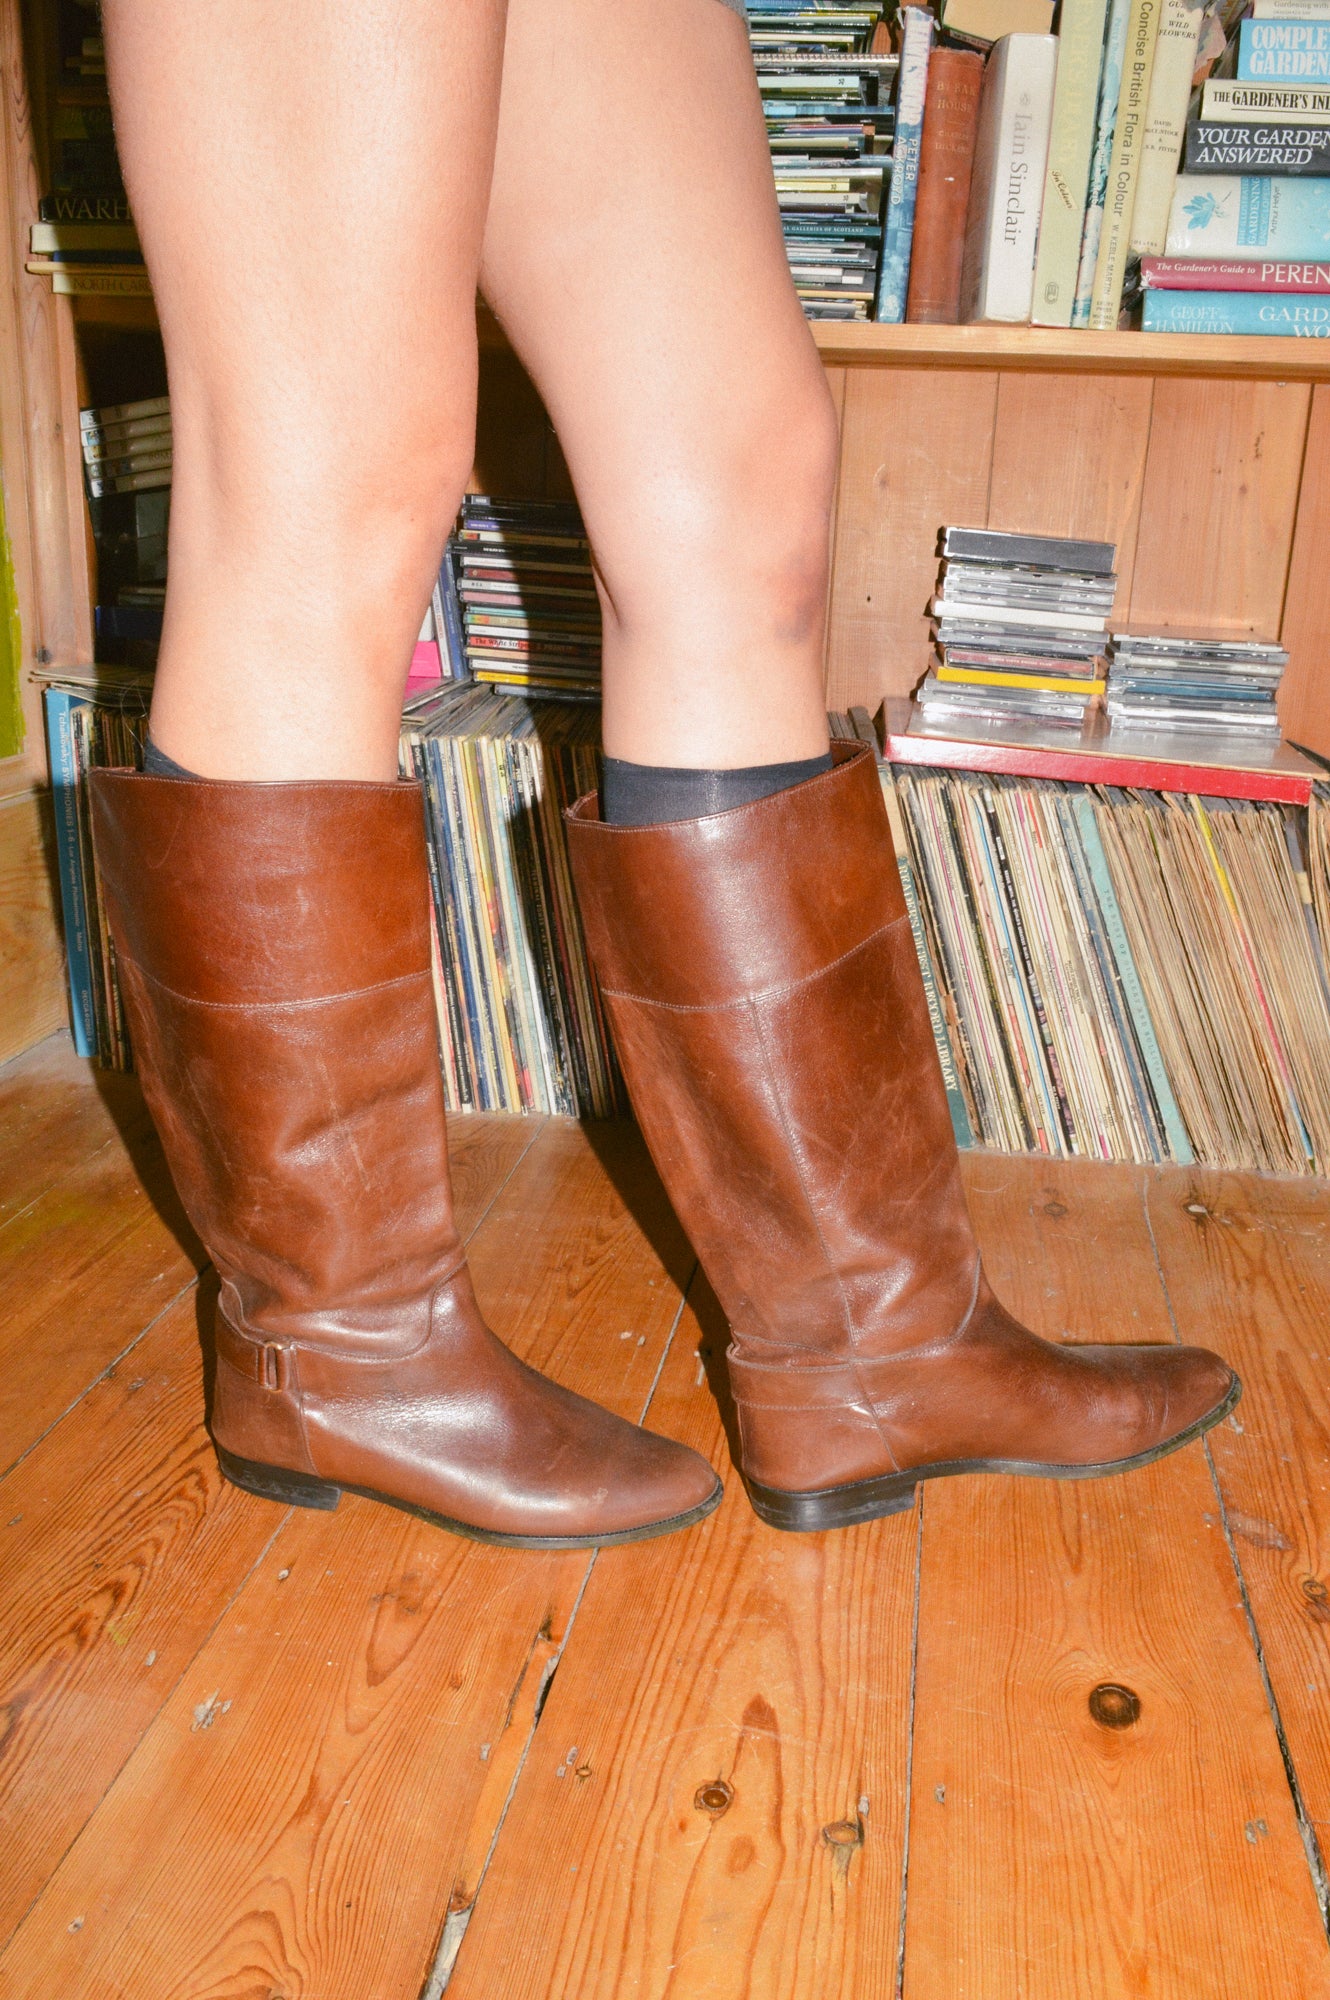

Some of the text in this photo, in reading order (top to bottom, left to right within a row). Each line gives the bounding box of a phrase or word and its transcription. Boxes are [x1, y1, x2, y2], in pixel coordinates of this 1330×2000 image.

[1134, 1, 1153, 56] Concise
[1158, 29, 1196, 38] FLOWERS
[1168, 20, 1189, 28] WILD
[1128, 61, 1145, 107] British
[1213, 91, 1230, 103] THE
[1232, 90, 1308, 109] GARDENER'S
[1122, 112, 1138, 147] Flora
[1197, 128, 1251, 145] YOUR
[905, 138, 917, 181] PETER
[1119, 153, 1133, 166] in
[1195, 148, 1313, 165] ANSWERED
[890, 135, 906, 204] ACKROYD
[1003, 112, 1032, 245] Iain Sinclair
[1049, 168, 1062, 182] In
[1113, 170, 1130, 217] Colour
[1247, 177, 1260, 244] GARDENING
[1270, 209, 1278, 233] Arthur
[1107, 235, 1117, 261] KEBLE
[1102, 263, 1113, 295] MARTIN
[1156, 262, 1172, 271] The
[1174, 263, 1217, 273] Gardener's
[1220, 265, 1246, 274] Guide
[1248, 266, 1256, 274] to
[1171, 306, 1218, 320] GEOFF
[1155, 319, 1234, 333] HAMILTON
[61, 766, 73, 825] SYMPHONIES
[1118, 943, 1126, 955] OF
[896, 864, 958, 1092] READER'S DIGEST RECORD LIBRARY
